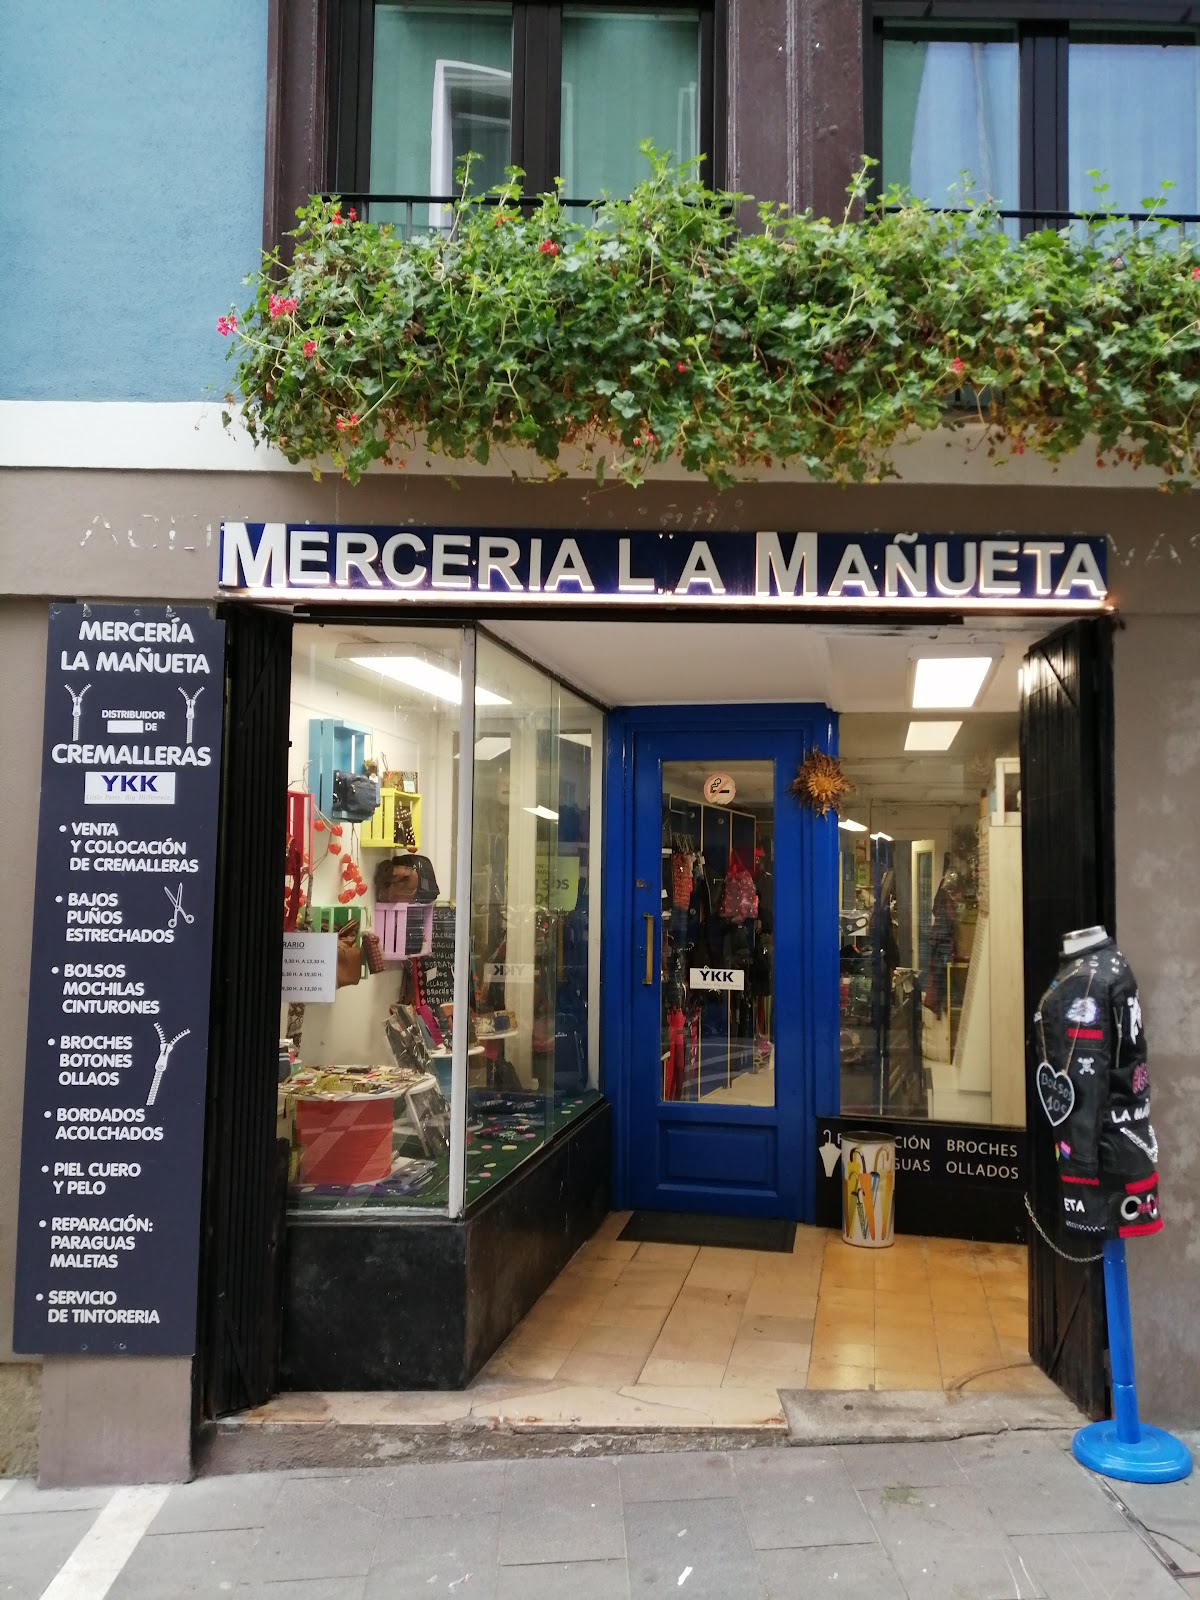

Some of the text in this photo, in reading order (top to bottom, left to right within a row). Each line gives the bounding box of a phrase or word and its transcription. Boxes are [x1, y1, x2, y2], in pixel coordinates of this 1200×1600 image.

[222, 522, 595, 591] MERCERIA
[755, 532, 1108, 597] MAÑUETA
[79, 617, 194, 643] MERCERÍA
[61, 647, 210, 674] LA MAÑUETA
[102, 710, 165, 719] DISTRIBUIDOR
[145, 723, 157, 731] DE
[52, 744, 211, 766] CREMALLERAS
[101, 775, 159, 792] YKK
[72, 822, 118, 836] VENTA
[71, 838, 186, 855] Y COLOCACIÓN
[70, 858, 198, 872] DE CREMALLERAS
[68, 893, 118, 907] BAJOS
[67, 907, 122, 925] PUÑOS
[66, 928, 174, 943] ESTRECHADOS
[64, 964, 125, 978] BOLSOS
[699, 970, 734, 982] YKK
[63, 982, 144, 996] MOCHILAS
[62, 1000, 159, 1014] CINTURONES
[60, 1036, 132, 1050] BROCHES
[60, 1054, 132, 1068] BOTONES
[59, 1072, 119, 1086] OLLAOS
[57, 1108, 145, 1122] BORDADOS
[1111, 1109, 1131, 1124] LA
[56, 1126, 163, 1140] ACOLCHADOS
[946, 1139, 1018, 1158] BROCHES
[54, 1163, 141, 1177] PIEL CUERO
[945, 1161, 1019, 1180] OLLADOS
[53, 1181, 106, 1195] Y PELO
[52, 1214, 153, 1232] REPARACIÓN:
[51, 1236, 135, 1250] PARAGUAS
[50, 1254, 118, 1268] MALETAS
[49, 1290, 116, 1305] SERVICIO
[48, 1309, 160, 1323] DE TINTORERIA
